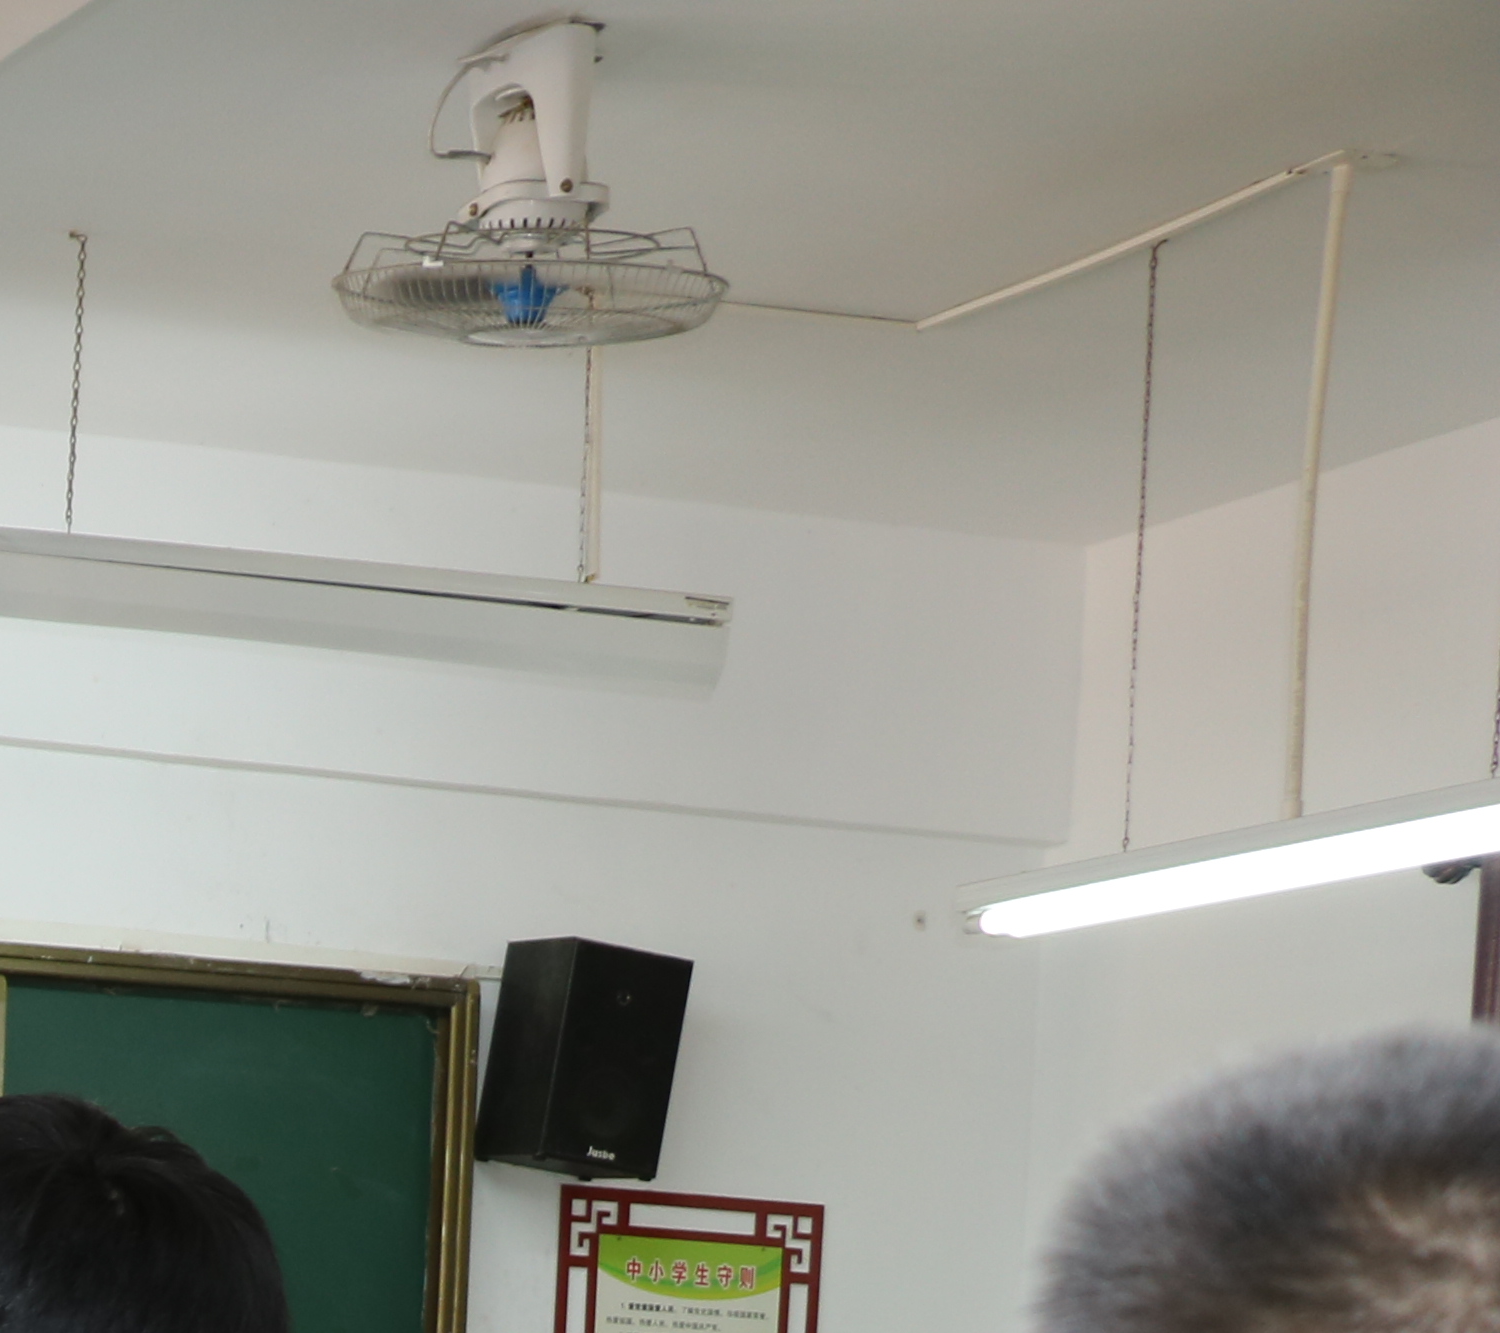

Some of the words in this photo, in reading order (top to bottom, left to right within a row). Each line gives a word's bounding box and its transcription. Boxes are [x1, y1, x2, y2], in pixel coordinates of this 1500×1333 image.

[625, 1256, 757, 1291] 中小学生守则
